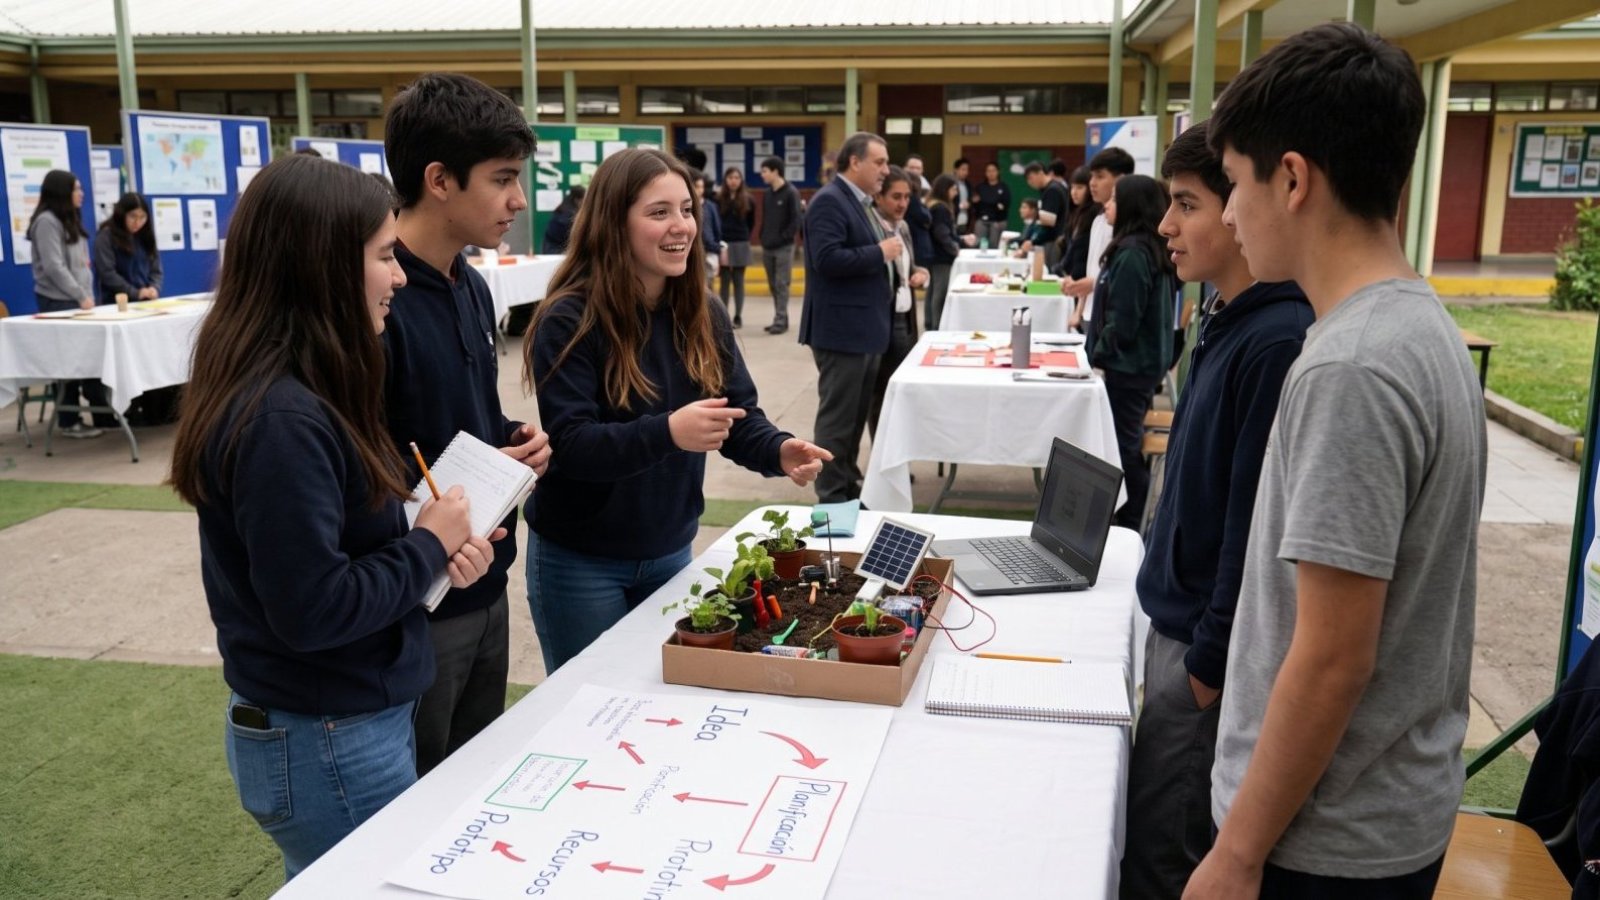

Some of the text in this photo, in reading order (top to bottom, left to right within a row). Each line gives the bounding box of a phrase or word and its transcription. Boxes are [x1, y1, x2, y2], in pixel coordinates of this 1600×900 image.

[694, 704, 749, 740] Idea
[430, 810, 510, 875] Prototipo
[768, 782, 832, 855] Planificación
[525, 829, 600, 897] Recursos
